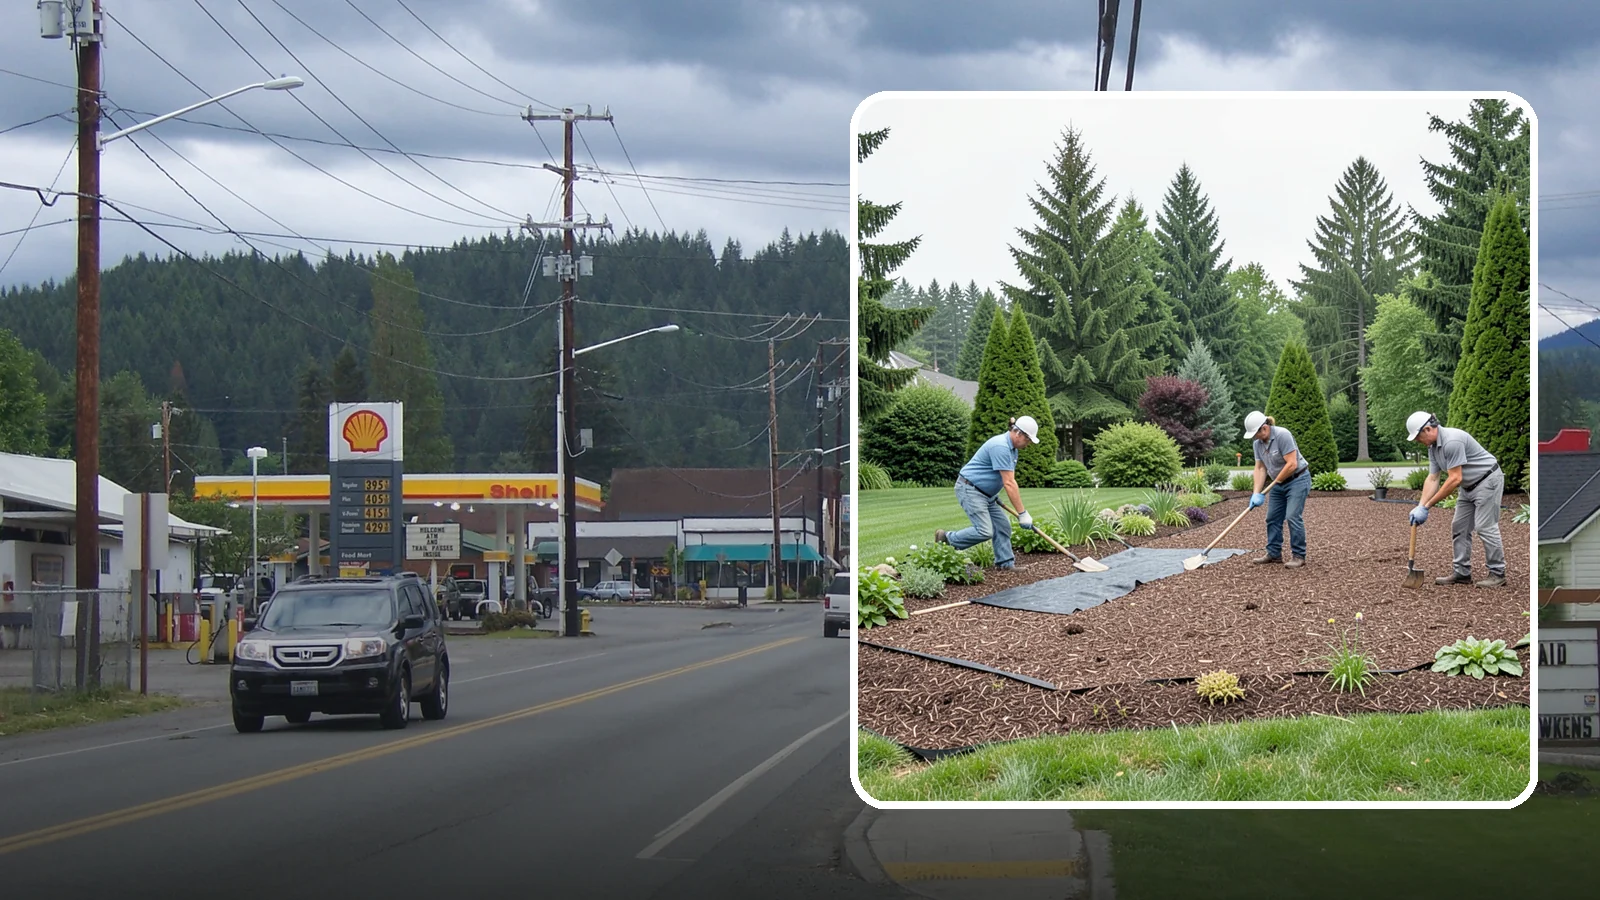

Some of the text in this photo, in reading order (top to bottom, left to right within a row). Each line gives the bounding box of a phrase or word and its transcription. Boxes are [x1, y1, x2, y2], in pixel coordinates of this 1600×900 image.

[366, 480, 383, 490] 395
[490, 484, 547, 499] Shell
[366, 494, 383, 504] 405
[366, 508, 383, 518] 415
[366, 522, 383, 532] 429
